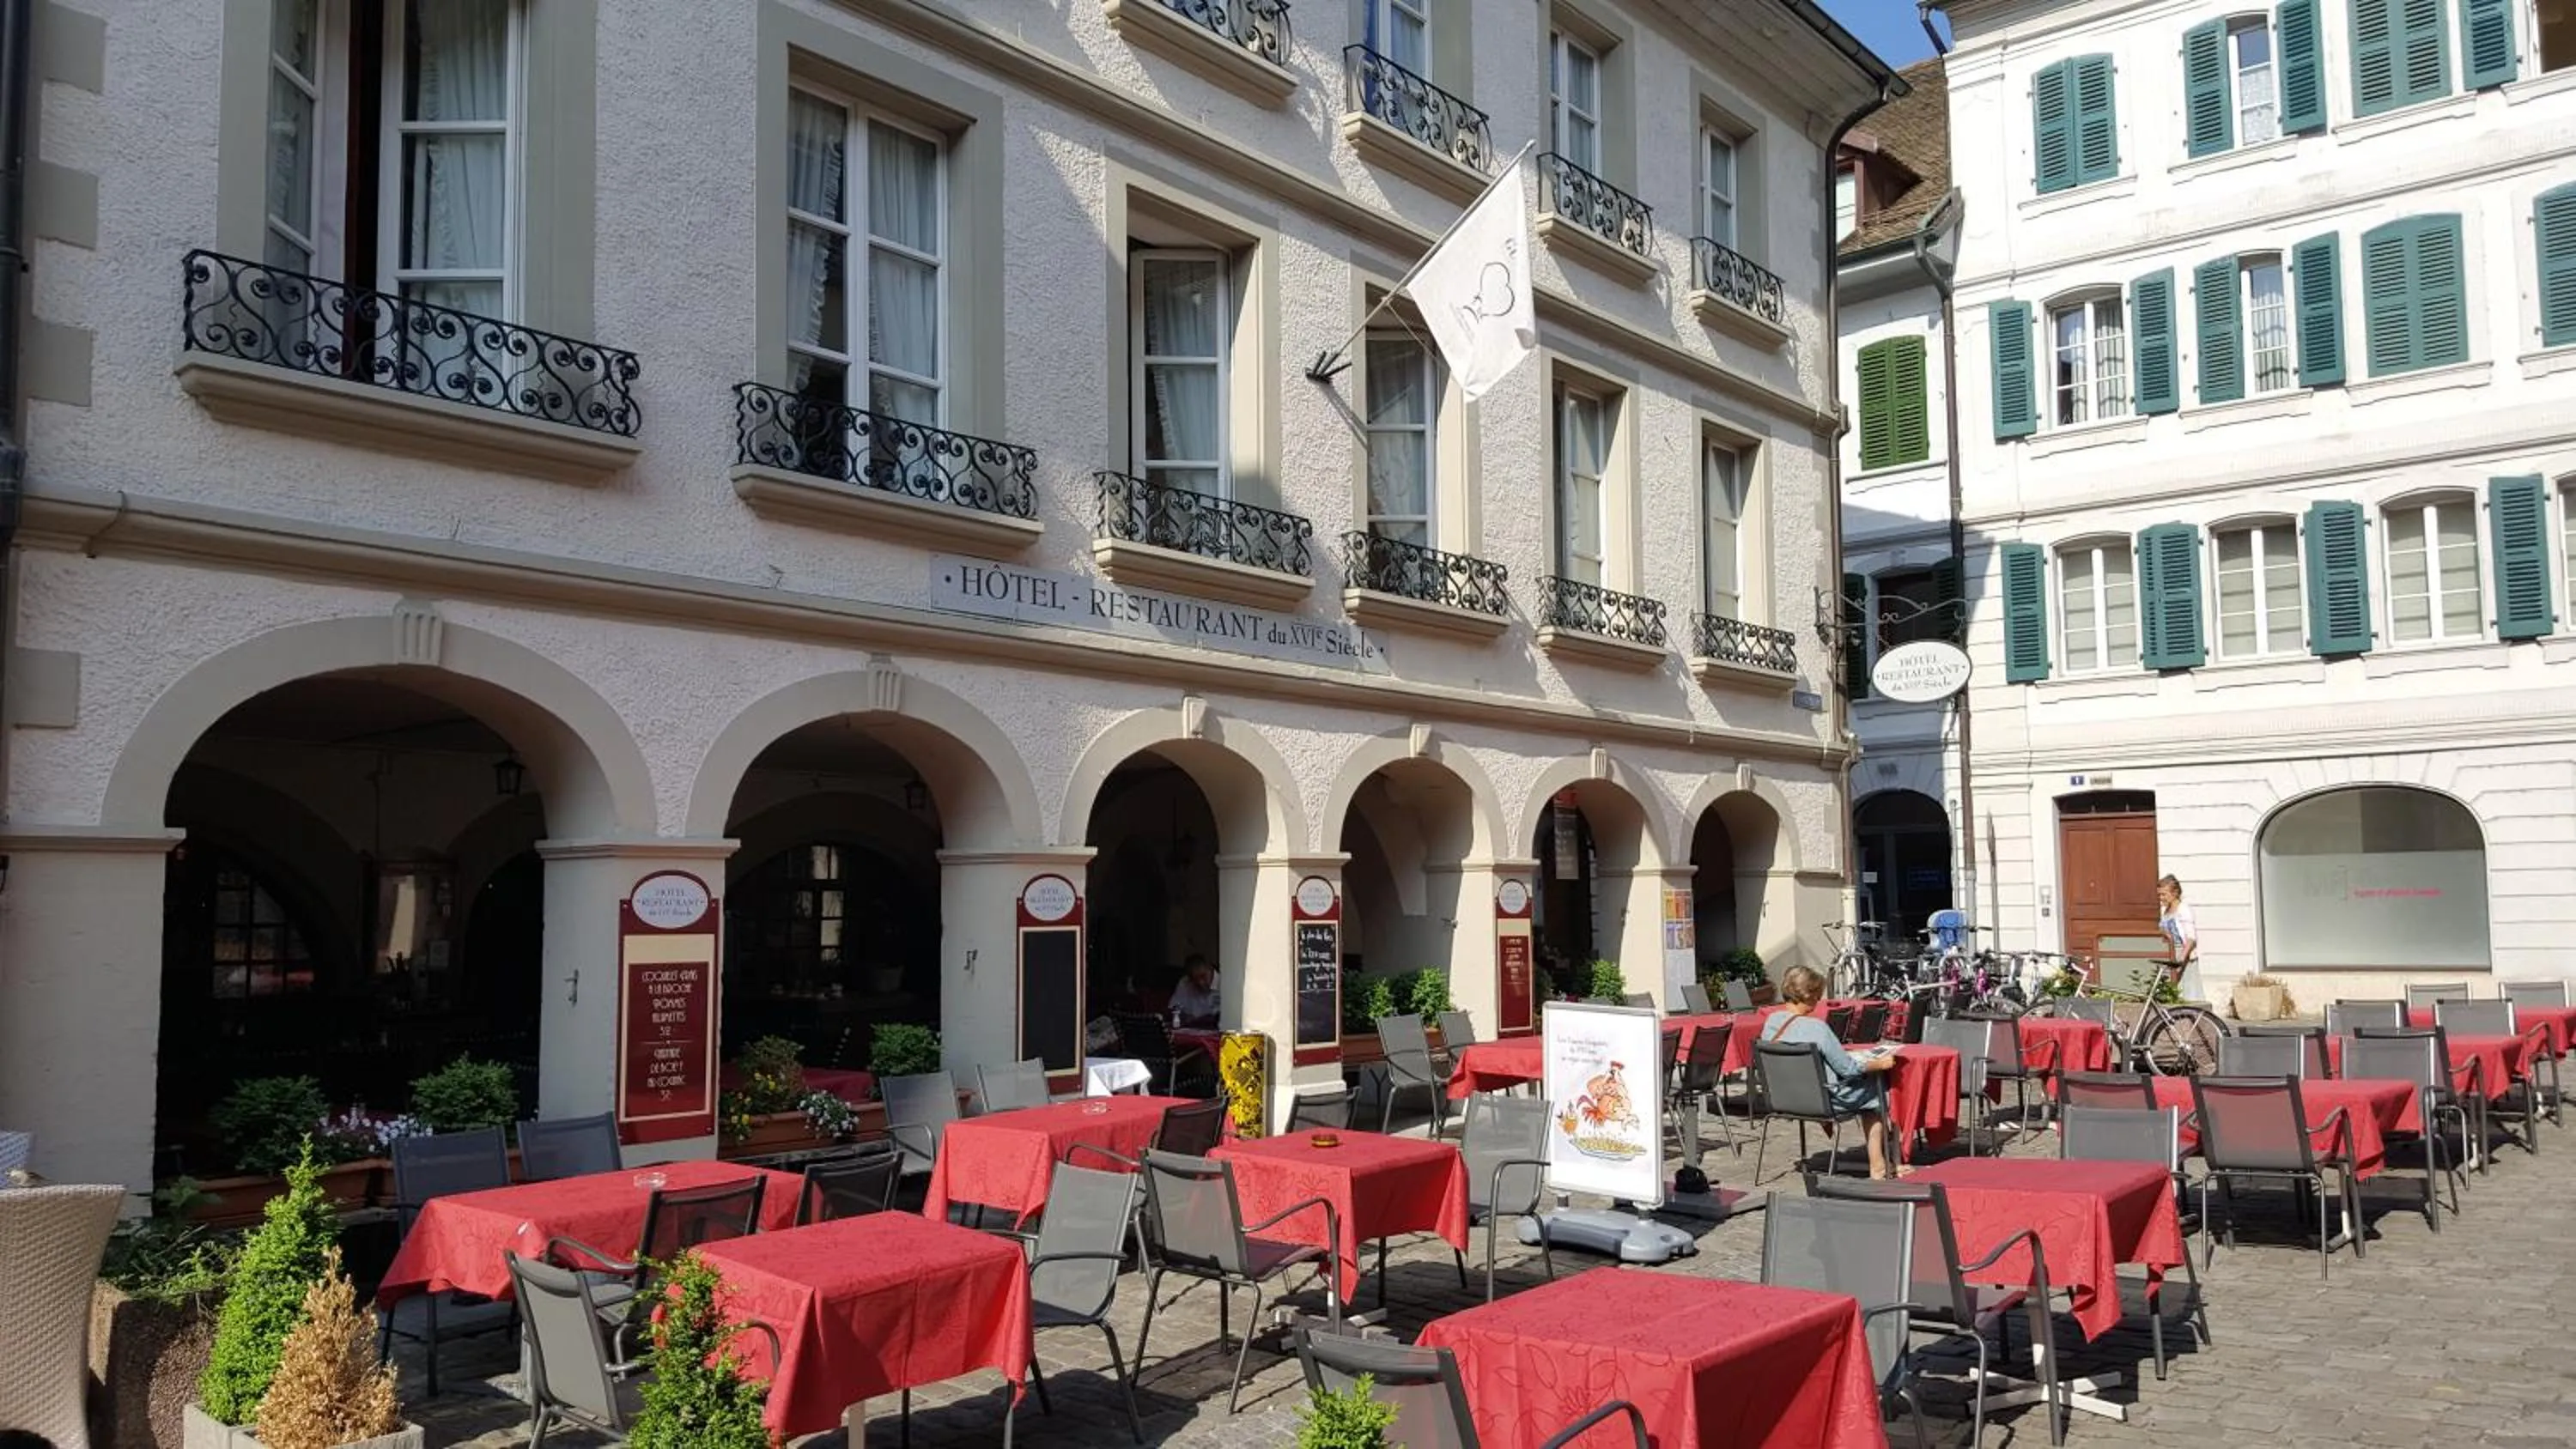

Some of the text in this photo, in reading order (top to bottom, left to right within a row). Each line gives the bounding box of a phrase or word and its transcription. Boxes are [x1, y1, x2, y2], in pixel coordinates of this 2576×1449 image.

[960, 563, 1066, 610] HÔTEL
[1089, 587, 1263, 641] RESTAURANT
[1267, 621, 1286, 645] du
[1326, 629, 1374, 658] Siècle
[1881, 664, 1959, 681] RESTAURANT
